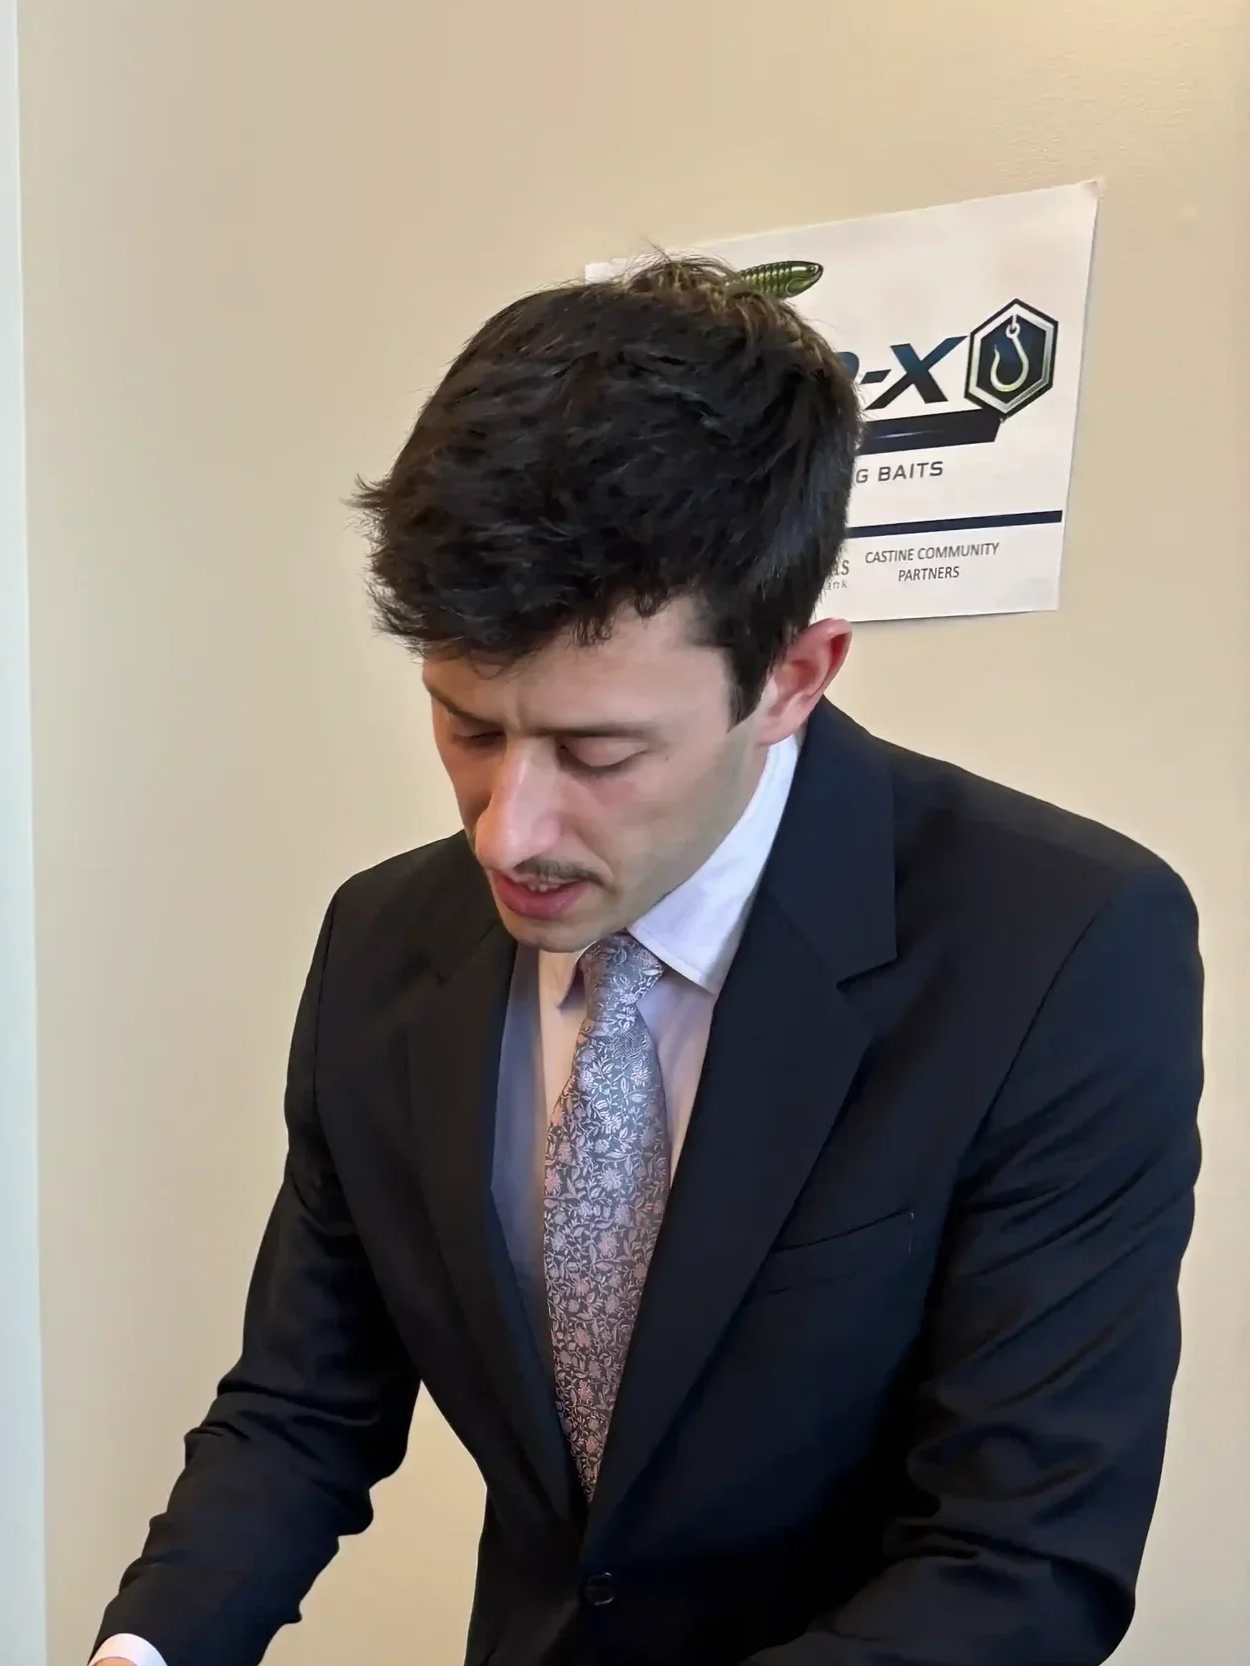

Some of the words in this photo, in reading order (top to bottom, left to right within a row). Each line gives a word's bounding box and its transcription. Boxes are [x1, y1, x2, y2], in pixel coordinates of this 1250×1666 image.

[878, 461, 943, 482] BAITS
[865, 548, 914, 564] CASTINE
[917, 542, 999, 560] COMMUNITY
[898, 566, 960, 581] PARTNERS
